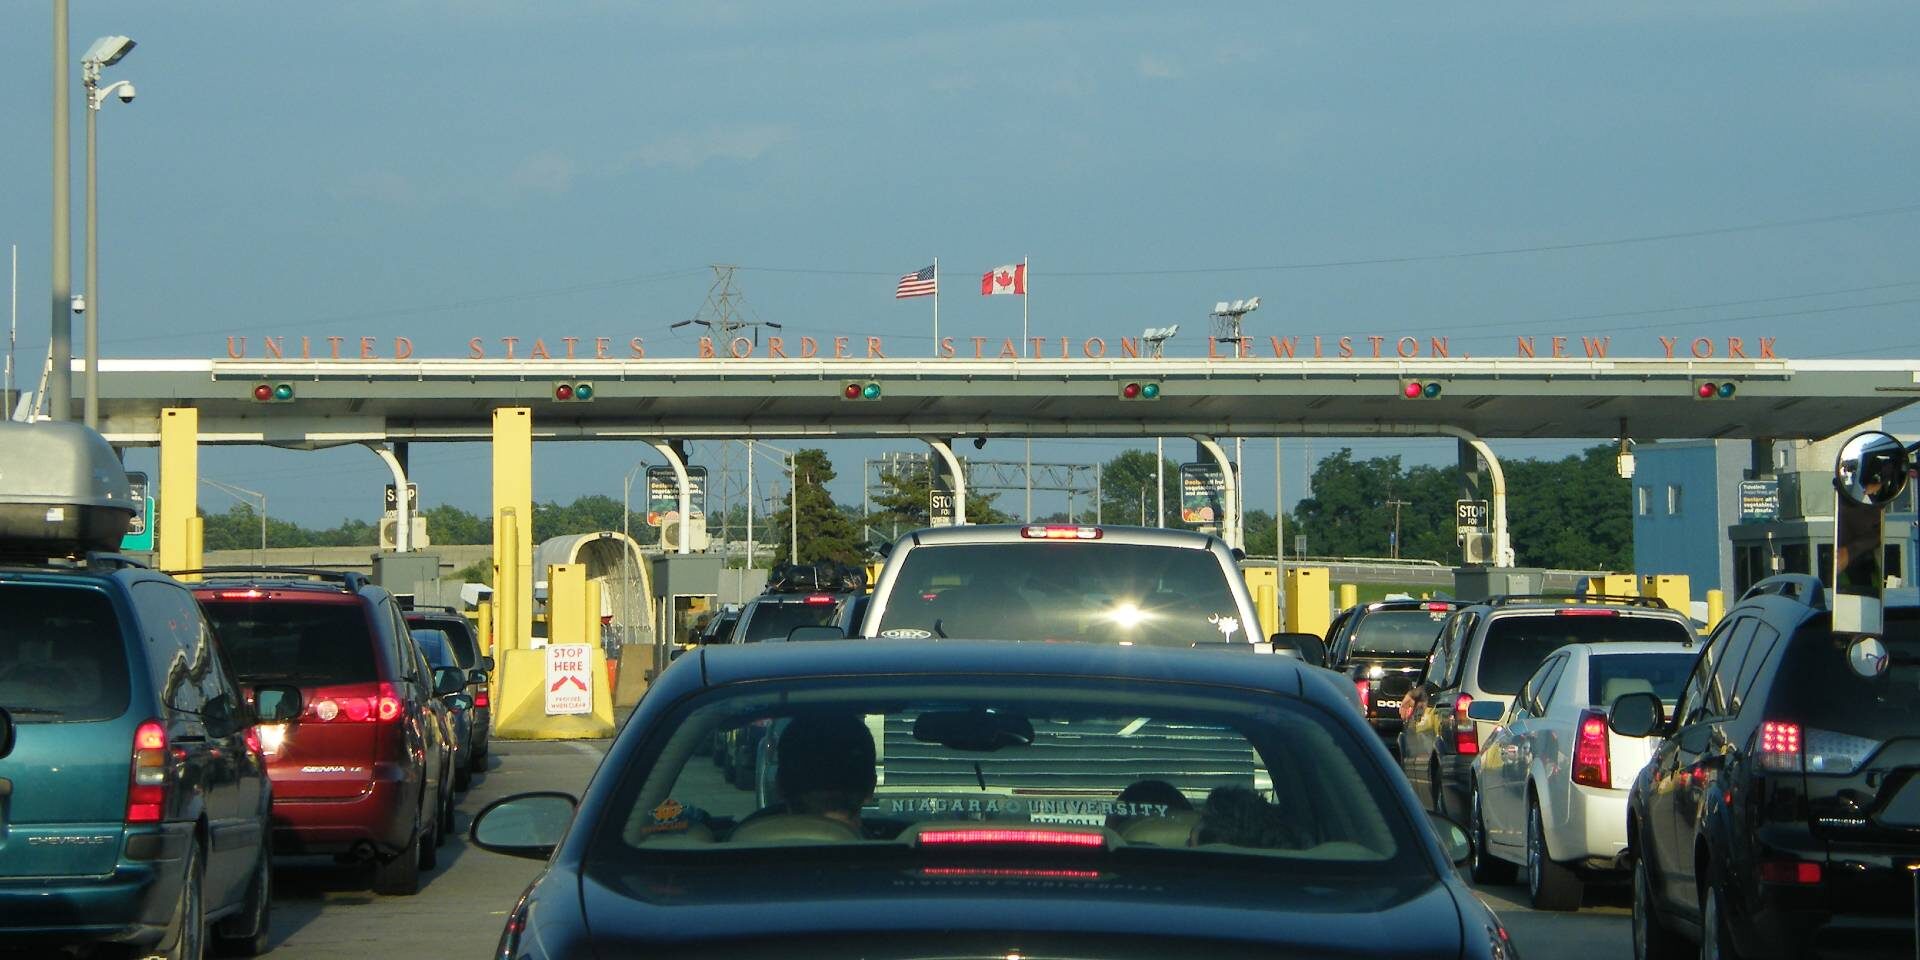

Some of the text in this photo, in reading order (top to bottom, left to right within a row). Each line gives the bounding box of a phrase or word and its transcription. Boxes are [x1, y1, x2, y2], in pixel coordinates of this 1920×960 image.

[227, 336, 414, 359] UNITED
[468, 336, 645, 359] STATES
[698, 336, 886, 359] BORDER
[1516, 335, 1611, 359] NEW
[1658, 335, 1777, 359] YORK
[387, 488, 415, 502] SP
[932, 495, 956, 508] STO
[1460, 505, 1486, 517] STOP
[554, 648, 583, 658] STOP
[554, 661, 583, 671] HERE
[301, 765, 346, 773] SIENNA
[891, 799, 1168, 817] NIAGARA UNIVERSITY
[28, 835, 113, 846] CHEVROLET
